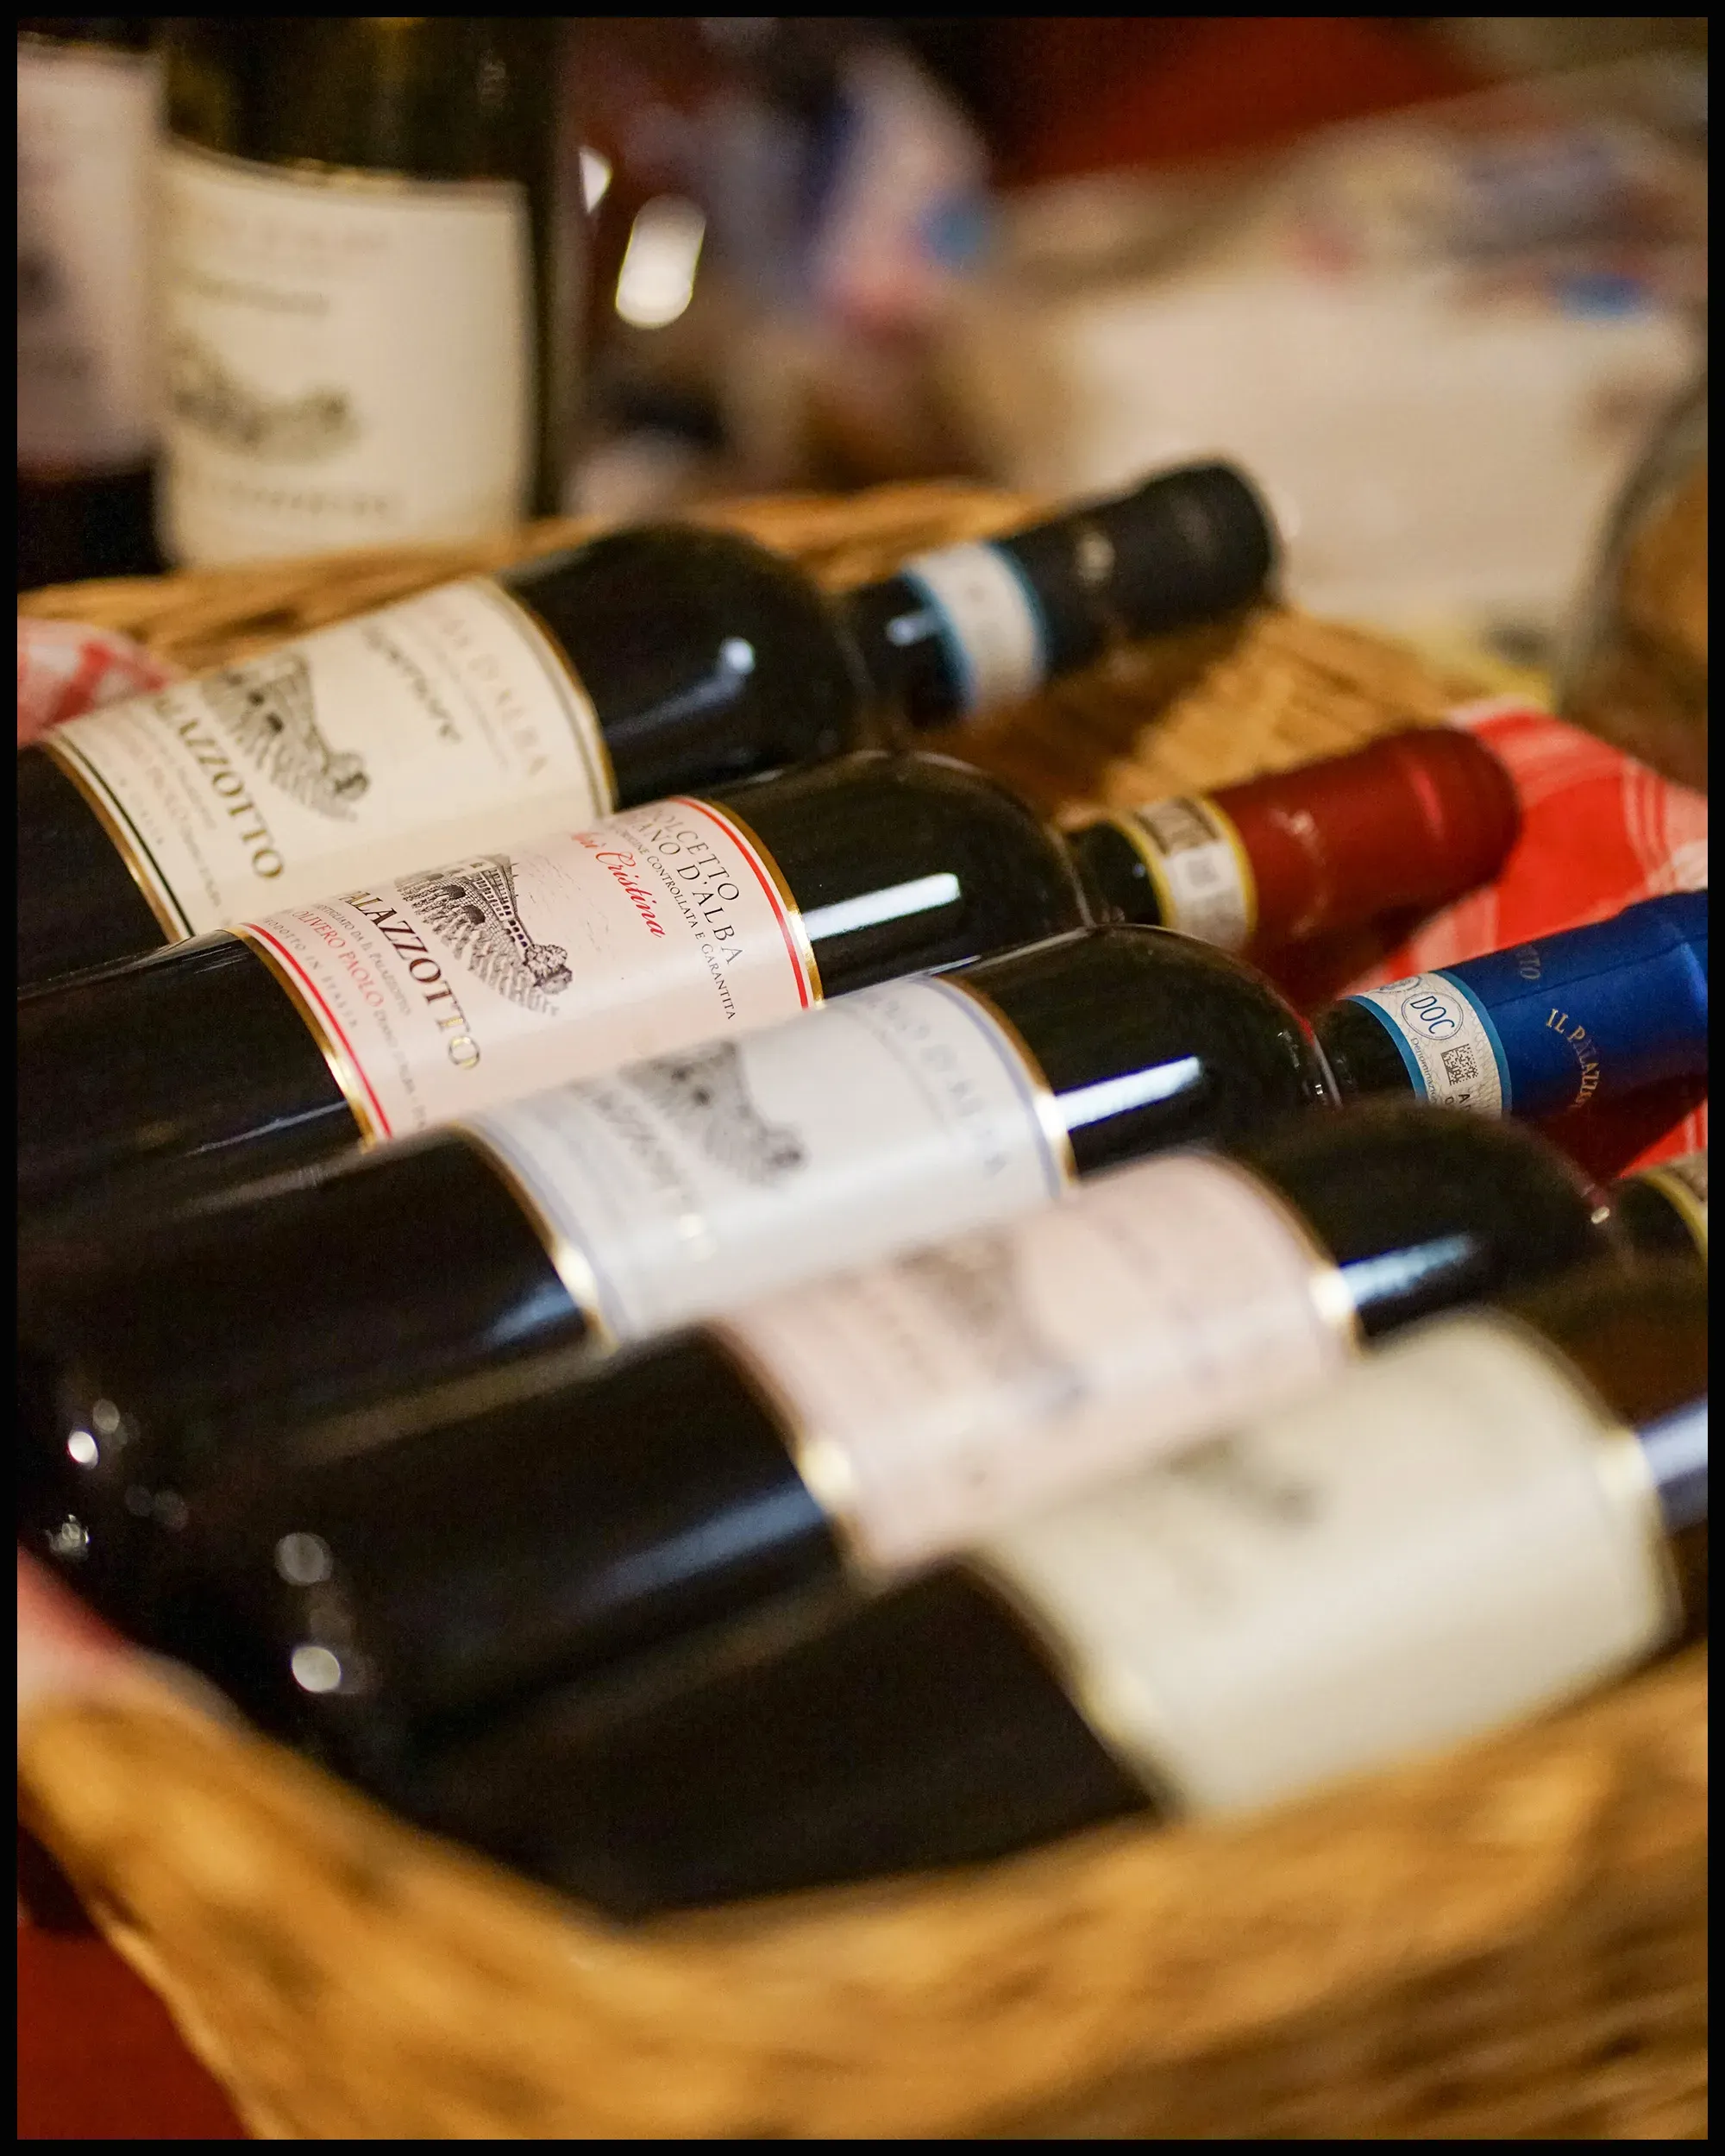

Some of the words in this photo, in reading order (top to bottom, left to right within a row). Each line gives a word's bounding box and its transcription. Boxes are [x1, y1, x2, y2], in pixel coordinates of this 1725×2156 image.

[595, 851, 666, 938] Cristina
[647, 855, 698, 927] CONTROLLATA
[694, 931, 706, 940] E
[701, 944, 736, 1020] GARANTITA
[676, 864, 744, 965] D'ALBA
[338, 951, 384, 1007] PAOLO
[338, 890, 480, 1070] ALAZZOTTO
[1409, 995, 1455, 1034] DOC
[1545, 1009, 1569, 1034] IL
